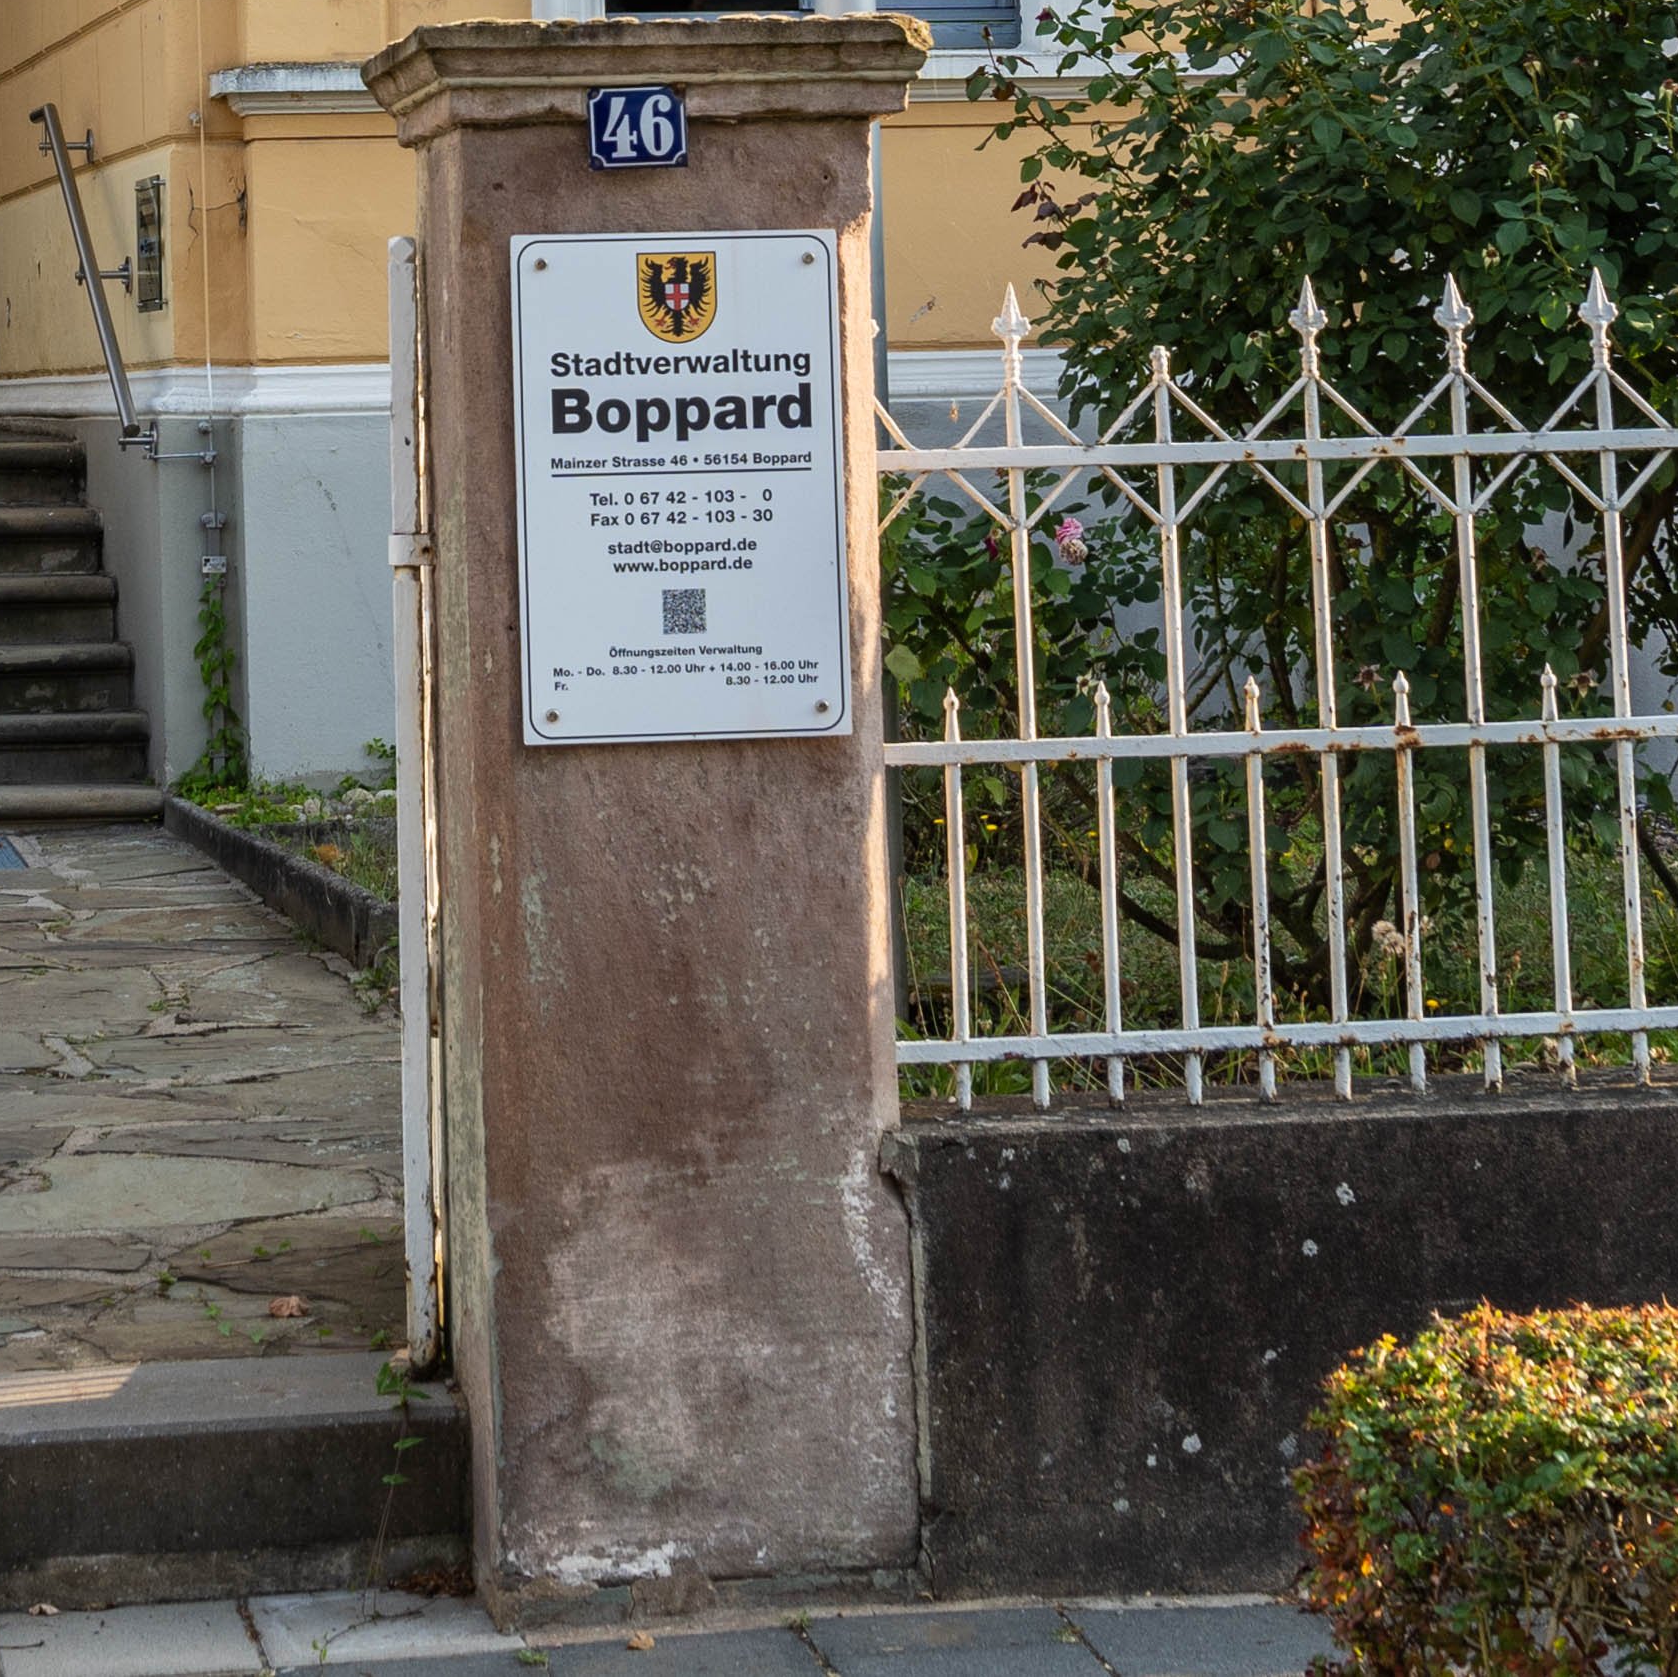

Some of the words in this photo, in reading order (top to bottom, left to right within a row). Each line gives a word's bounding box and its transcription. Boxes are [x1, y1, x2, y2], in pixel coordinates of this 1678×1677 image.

[602, 94, 674, 158] 46
[550, 349, 811, 377] Stadtverwaltung
[551, 382, 812, 442] Boppard
[551, 457, 607, 470] Mainzer
[612, 456, 666, 468] Strasse
[670, 455, 688, 466] 46
[704, 454, 748, 465] 56154
[753, 452, 812, 467] Boppard
[589, 492, 618, 506] Tel.
[624, 492, 634, 505] 0
[640, 492, 659, 505] 67
[666, 491, 686, 504] 42
[705, 489, 735, 503] 103
[762, 489, 772, 502] 0
[590, 512, 619, 526] Fax
[624, 512, 635, 526] 0
[640, 512, 660, 525] 67
[666, 512, 687, 524] 42
[705, 510, 735, 523] 103
[753, 509, 773, 522] 30
[608, 538, 757, 556] stadt@boppard.de
[613, 556, 753, 574] www.boppard.de
[609, 646, 696, 659] Öffnungszeiten
[699, 644, 763, 657] Verwaltung
[553, 667, 574, 677] Mo.
[586, 666, 606, 677] Do.
[612, 665, 638, 676] 8.30
[651, 664, 681, 674] 12.00
[685, 663, 705, 673] Uhr
[720, 662, 751, 673] 14.00
[763, 661, 795, 671] 16.00
[798, 660, 819, 670] Uhr
[554, 681, 569, 691] Fr.
[726, 675, 751, 686] 8.30
[763, 674, 794, 685] 12.00
[798, 673, 819, 684] Uhr
